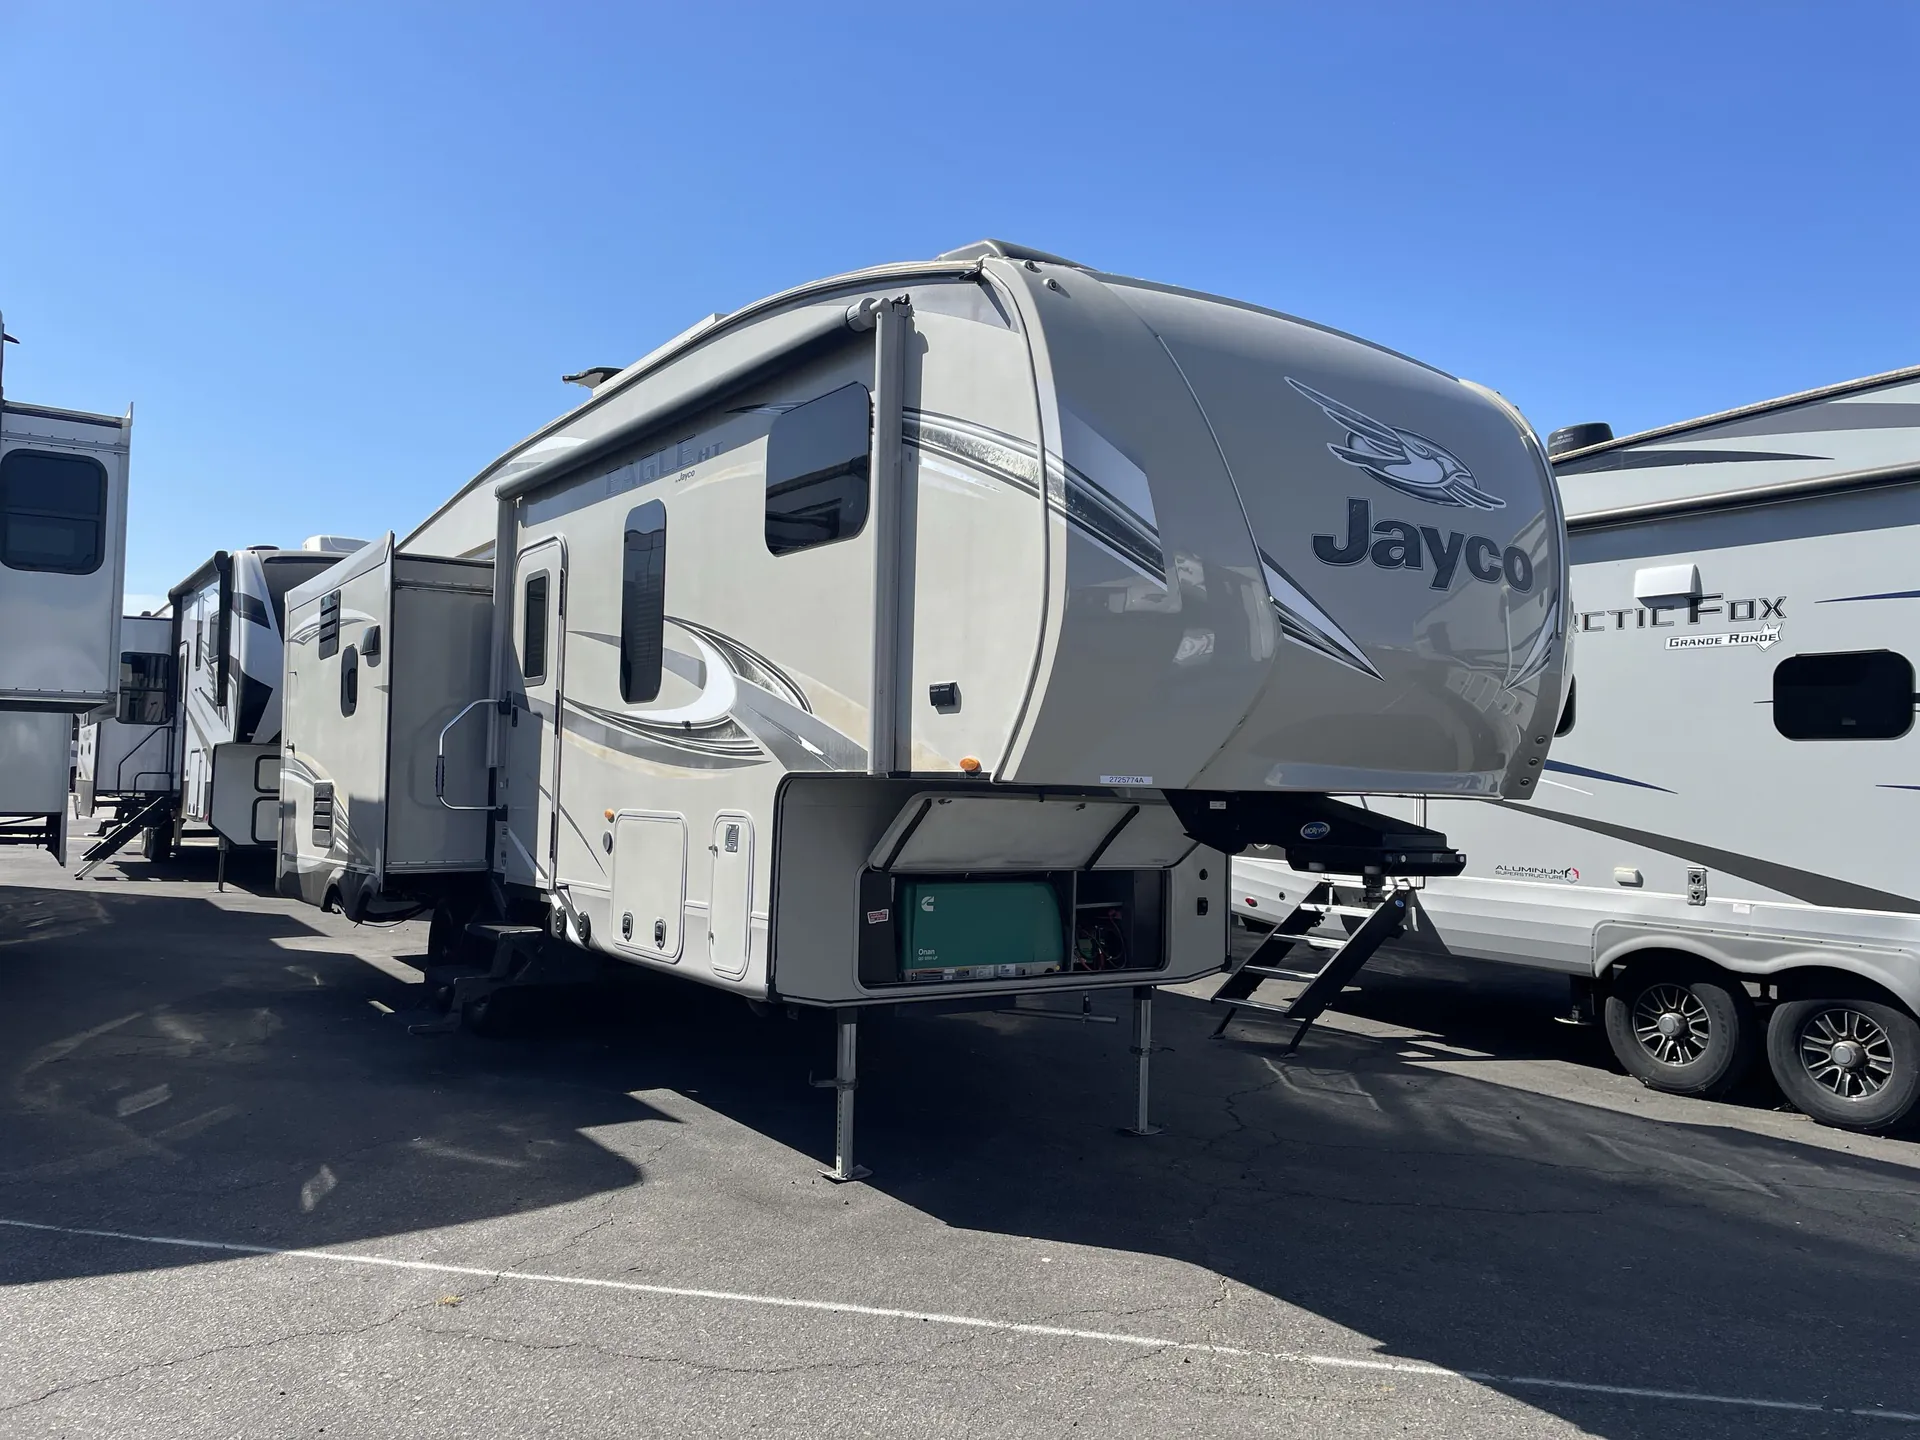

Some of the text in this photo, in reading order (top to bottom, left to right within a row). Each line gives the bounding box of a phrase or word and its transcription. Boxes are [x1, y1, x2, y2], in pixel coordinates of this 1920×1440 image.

[605, 433, 696, 496] EAGLE
[1311, 496, 1534, 593] Jayco
[1573, 605, 1674, 633] CTIC
[1669, 633, 1777, 648] GRANDE RONDE
[1495, 864, 1564, 875] ALUMINUM
[1495, 870, 1564, 880] SUPERSTRUCTURE
